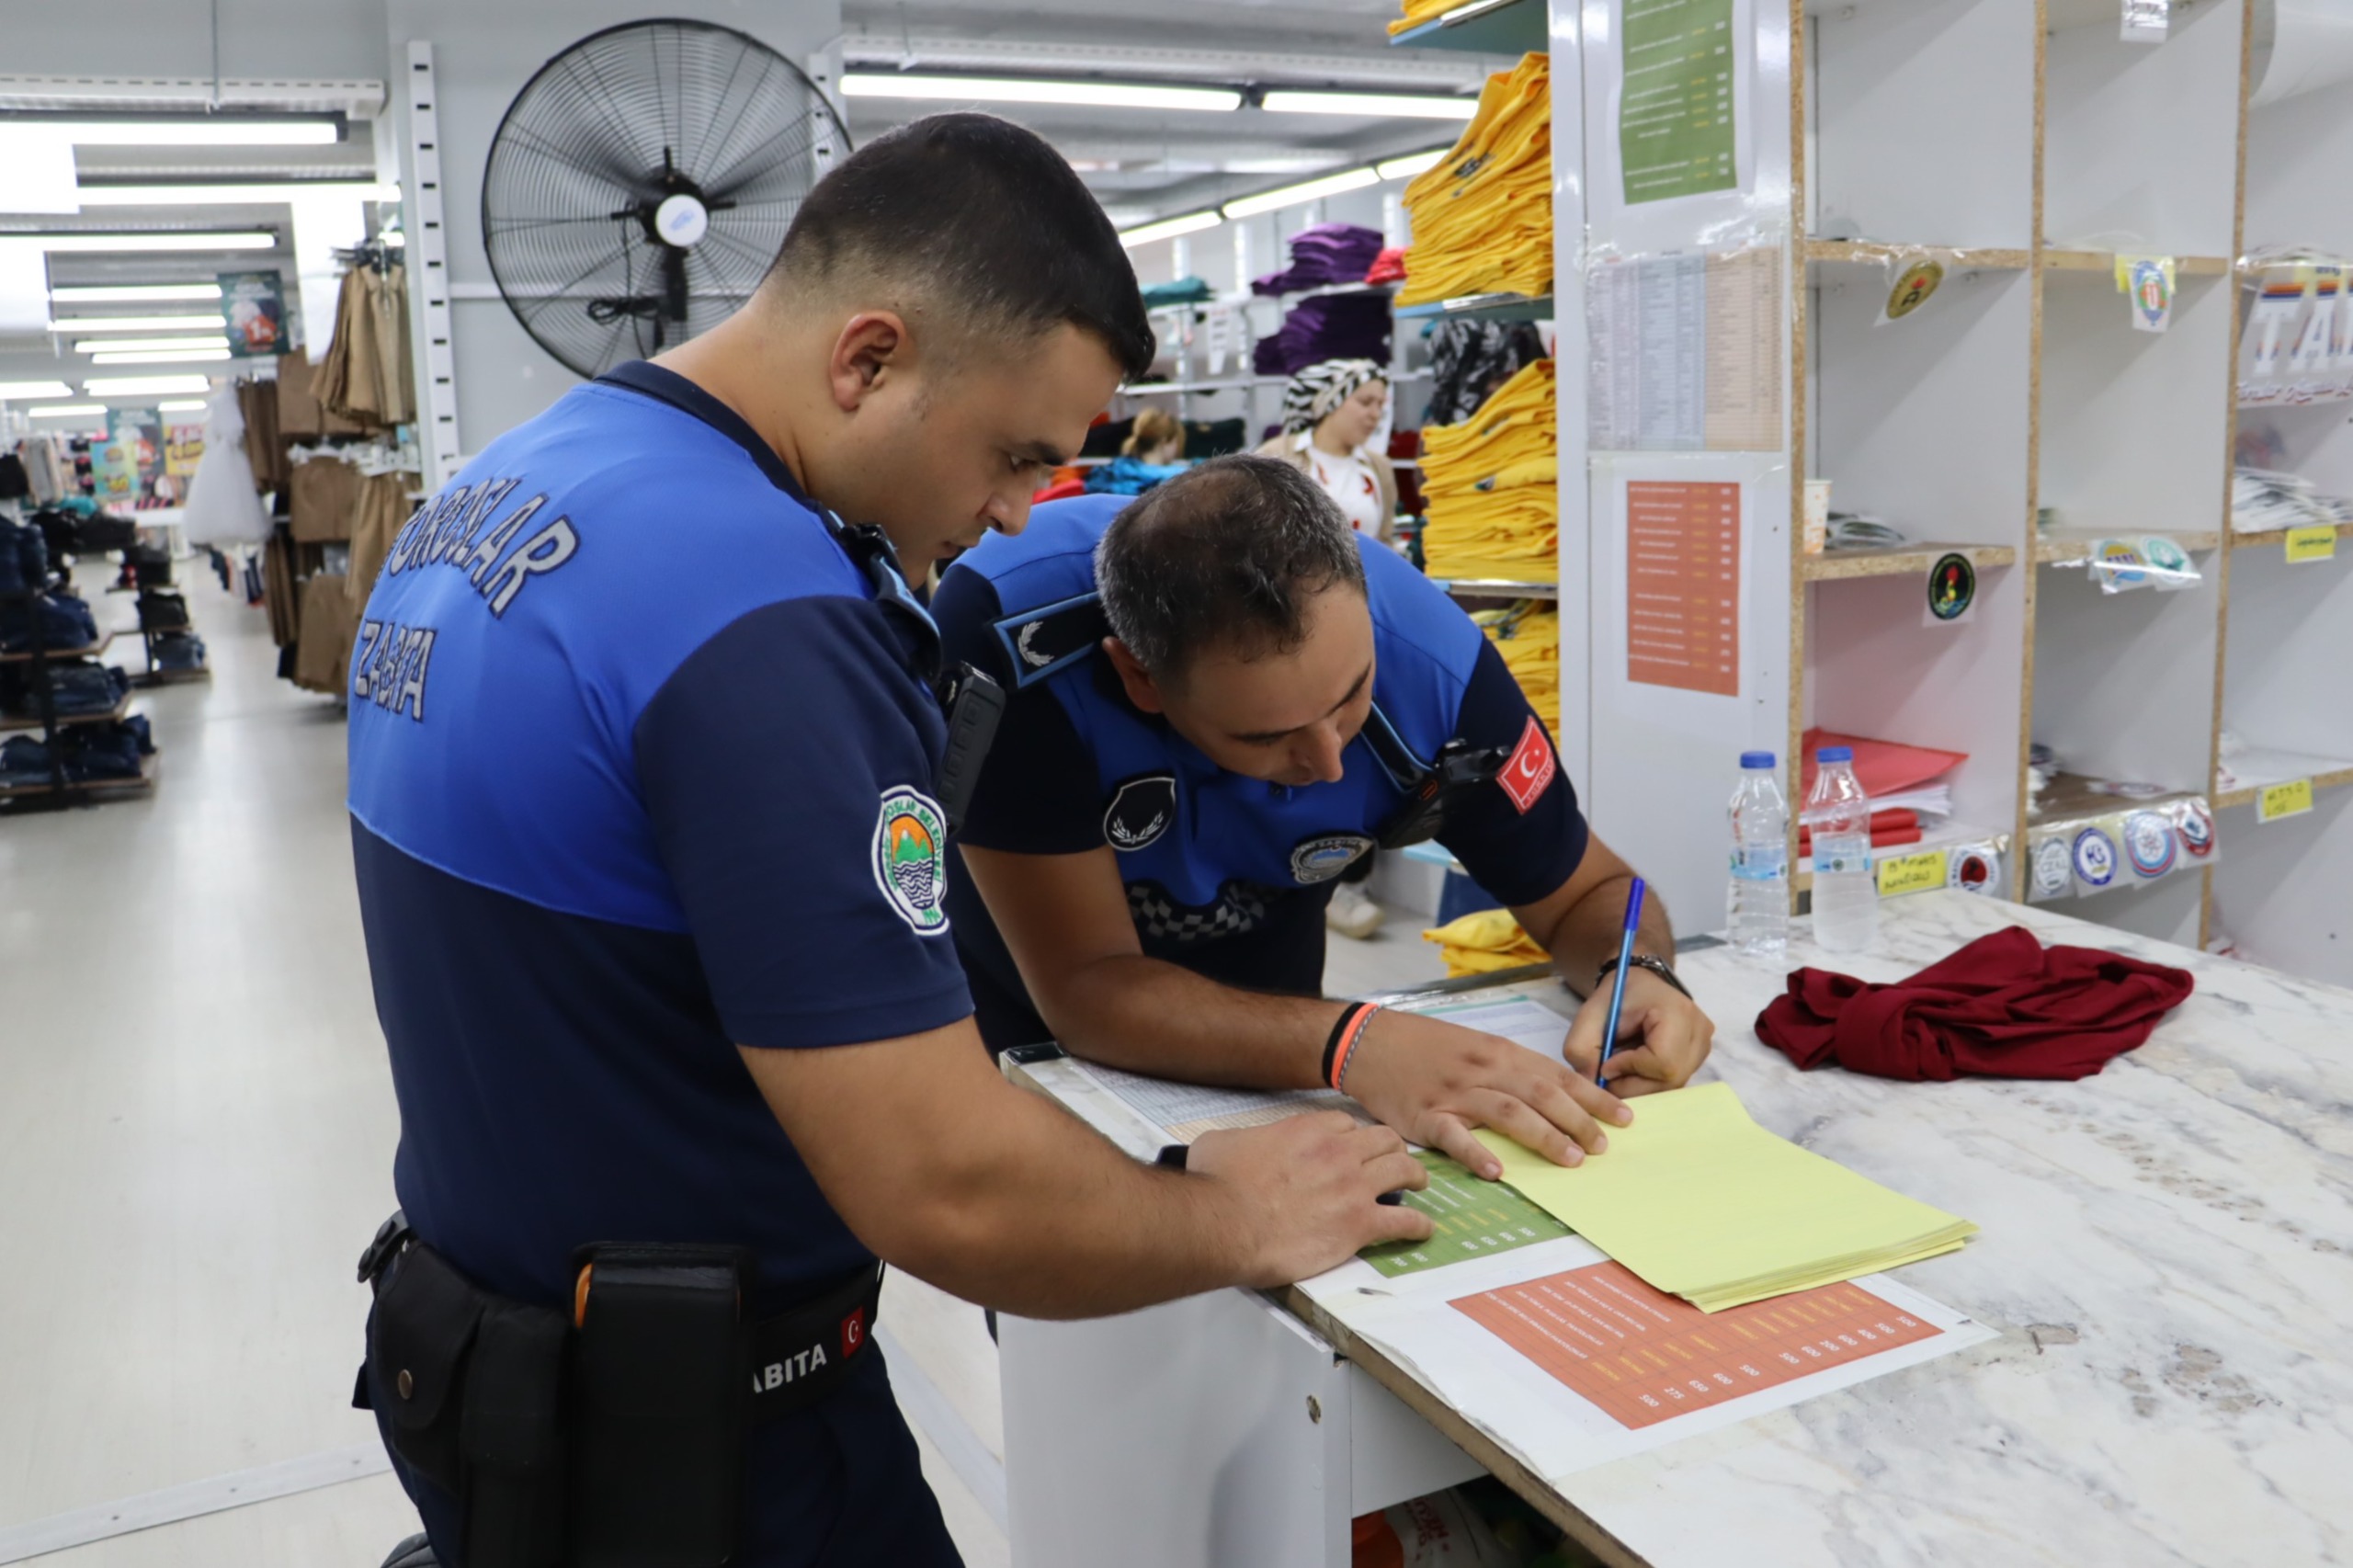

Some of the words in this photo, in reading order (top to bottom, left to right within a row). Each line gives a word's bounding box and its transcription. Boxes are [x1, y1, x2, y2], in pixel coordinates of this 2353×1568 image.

[384, 475, 581, 619] OROSLAR
[753, 1343, 827, 1394] BITA
[1739, 1364, 1760, 1377] 500
[1688, 1380, 1710, 1392] 650
[1639, 1393, 1660, 1407] 500
[1664, 1387, 1685, 1400] 275
